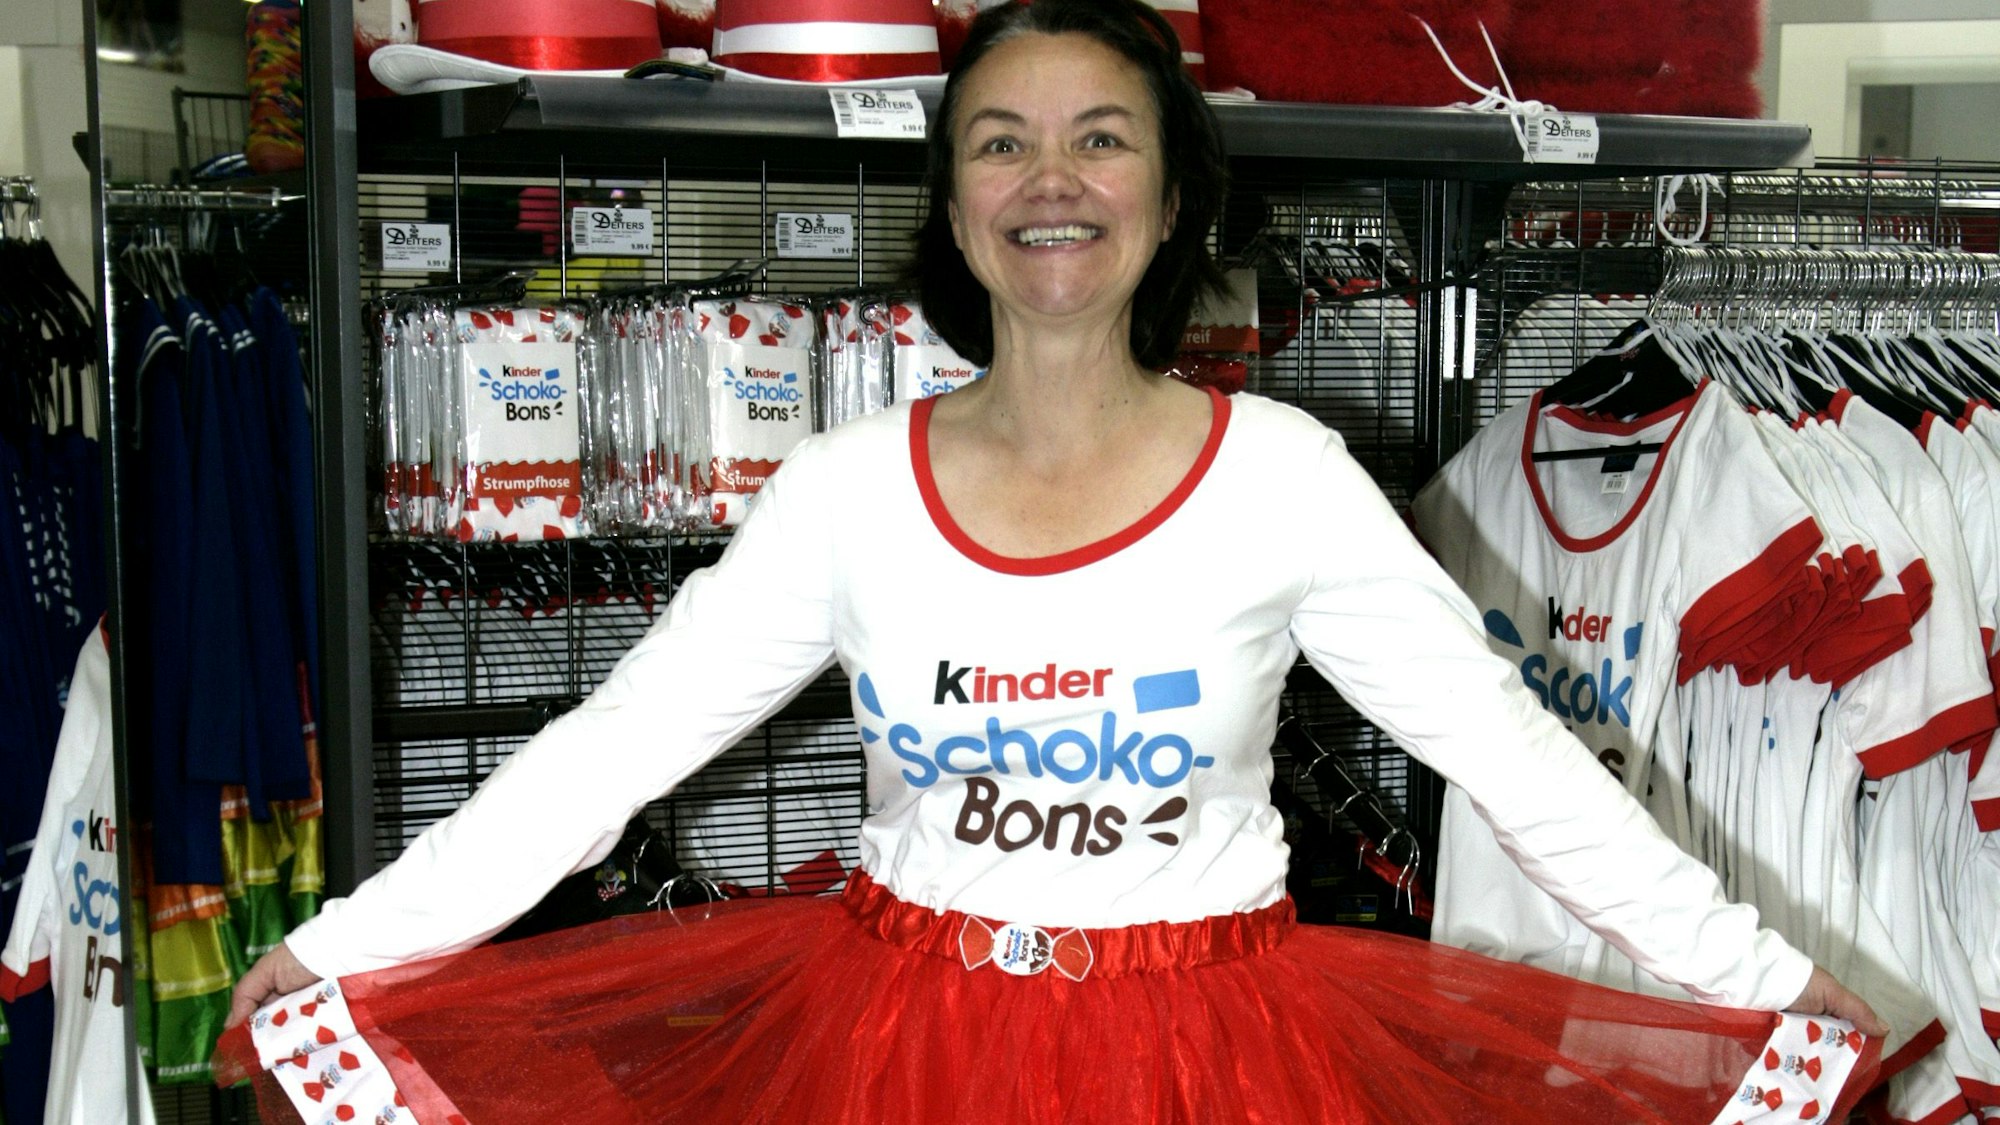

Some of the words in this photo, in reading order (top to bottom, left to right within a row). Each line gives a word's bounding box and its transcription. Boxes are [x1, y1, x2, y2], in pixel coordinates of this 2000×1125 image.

[852, 92, 914, 110] DEITERS
[1543, 119, 1592, 137] DEITERS
[592, 212, 645, 229] DEITERS
[795, 217, 845, 234] DEITERS
[385, 227, 442, 246] DEITERS
[502, 365, 541, 377] Kinder
[745, 365, 780, 379] Kinder
[932, 366, 972, 378] Kinder
[491, 381, 567, 400] Schoko-
[735, 380, 803, 402] Schoko-
[506, 402, 551, 421] Bons
[748, 402, 788, 421] Bons
[483, 475, 570, 492] Strumpfhose
[933, 660, 1113, 705] Kinder
[888, 711, 1215, 788] Schoko-
[954, 776, 1128, 857] Bons
